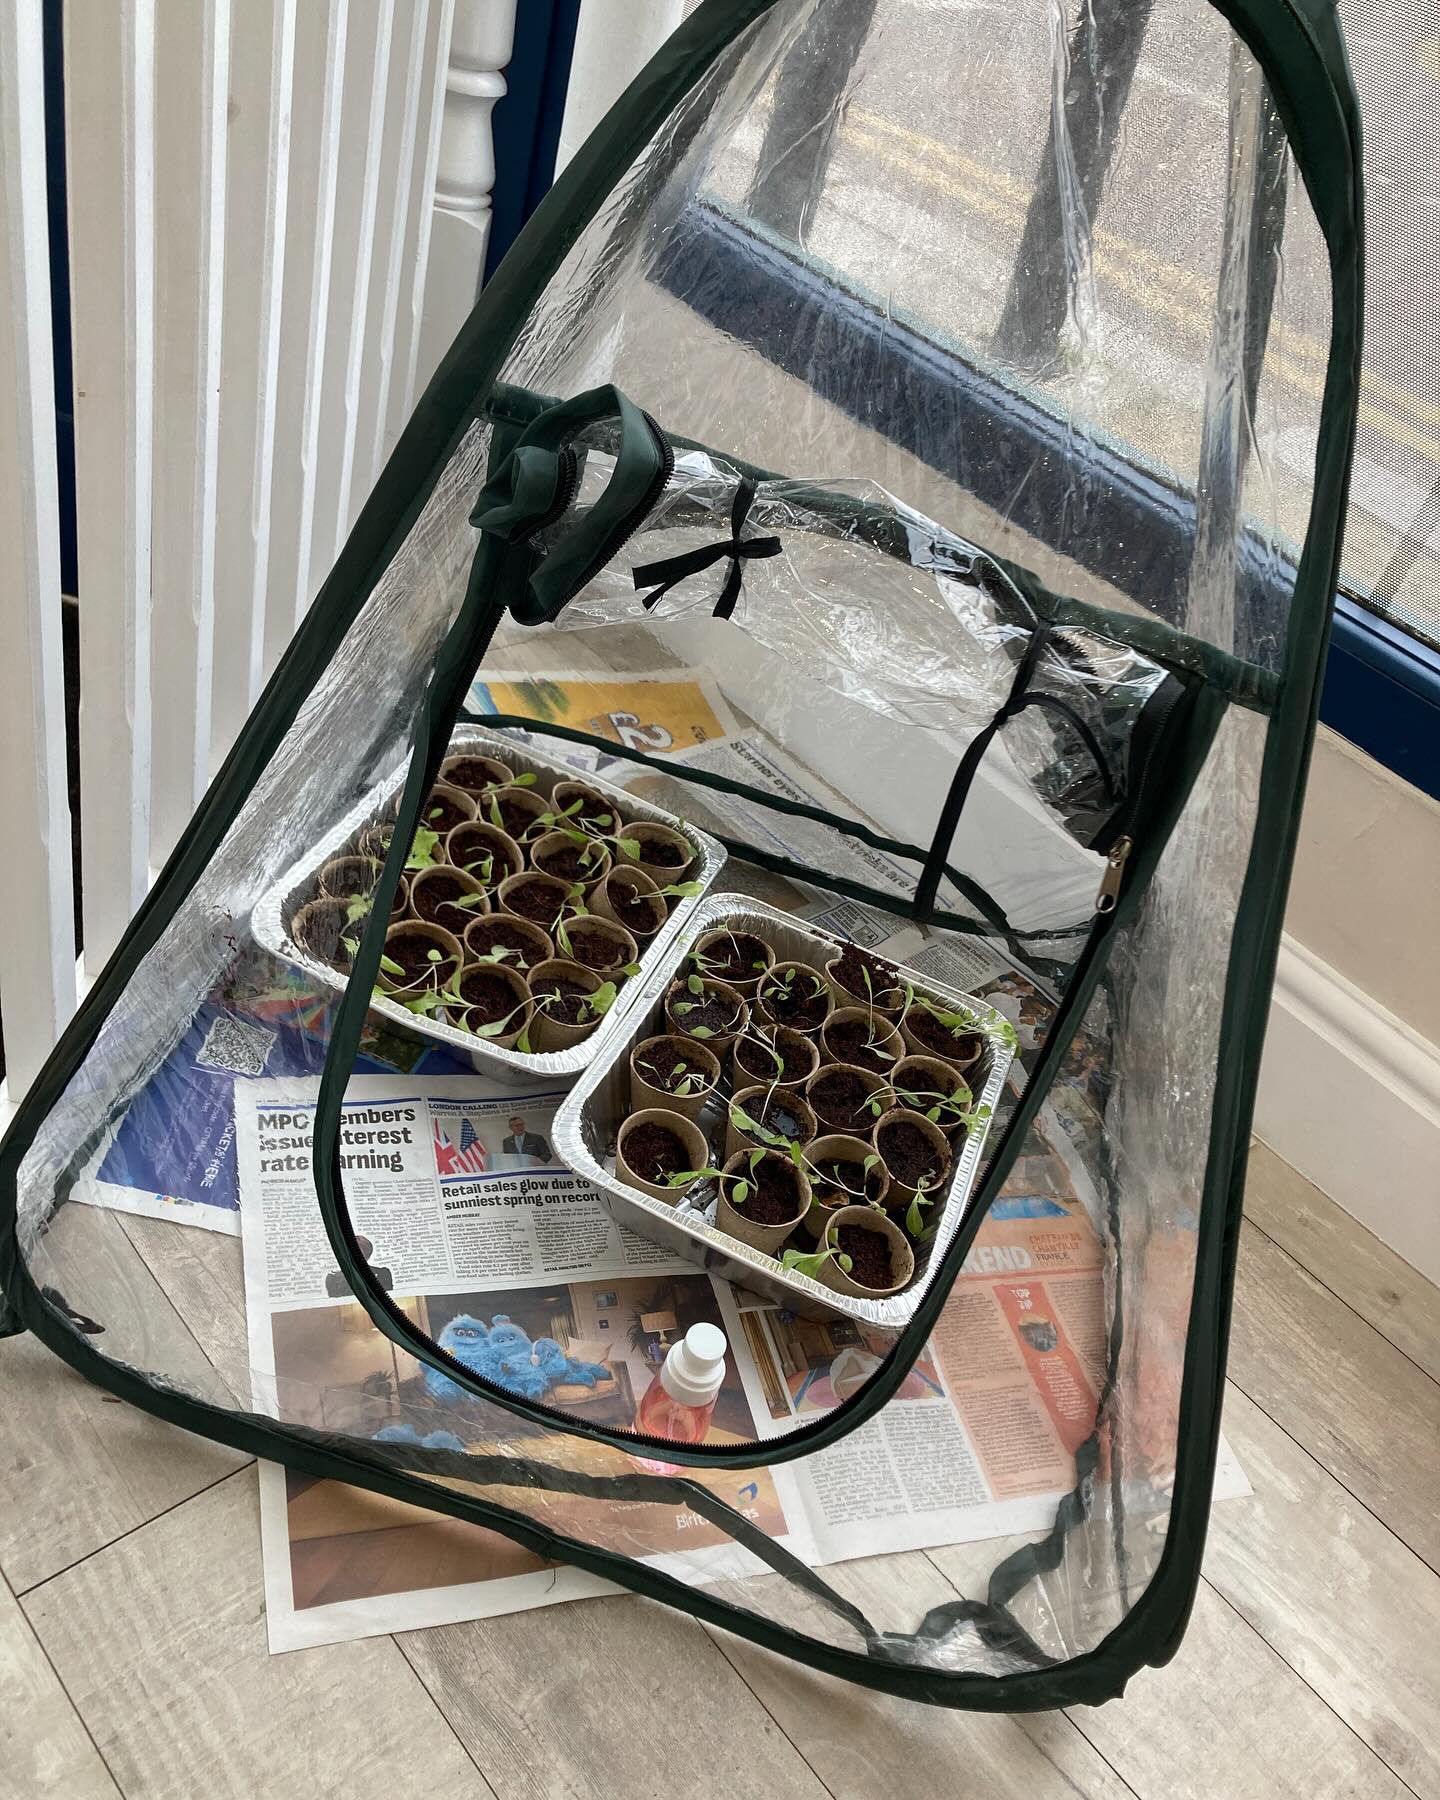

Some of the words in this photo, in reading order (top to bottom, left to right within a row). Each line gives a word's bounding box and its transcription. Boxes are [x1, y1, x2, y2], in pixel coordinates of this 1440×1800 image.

[730, 741, 777, 779] Starmer
[258, 1113, 310, 1131] MPC
[340, 1109, 416, 1125] embers
[259, 1134, 314, 1151] issue
[340, 1127, 413, 1145] terest
[260, 1154, 309, 1172] rate
[340, 1149, 404, 1172] arning
[200, 1159, 221, 1189] HERE
[442, 1183, 482, 1198] Retail
[483, 1180, 518, 1193] sales
[520, 1179, 549, 1194] glow
[551, 1178, 574, 1190] due
[576, 1178, 590, 1189] to
[444, 1195, 501, 1211] sunniest
[503, 1192, 543, 1208] spring
[544, 1194, 561, 1204] on
[960, 1245, 1031, 1273] KEND
[1036, 1252, 1071, 1261] FRANCE
